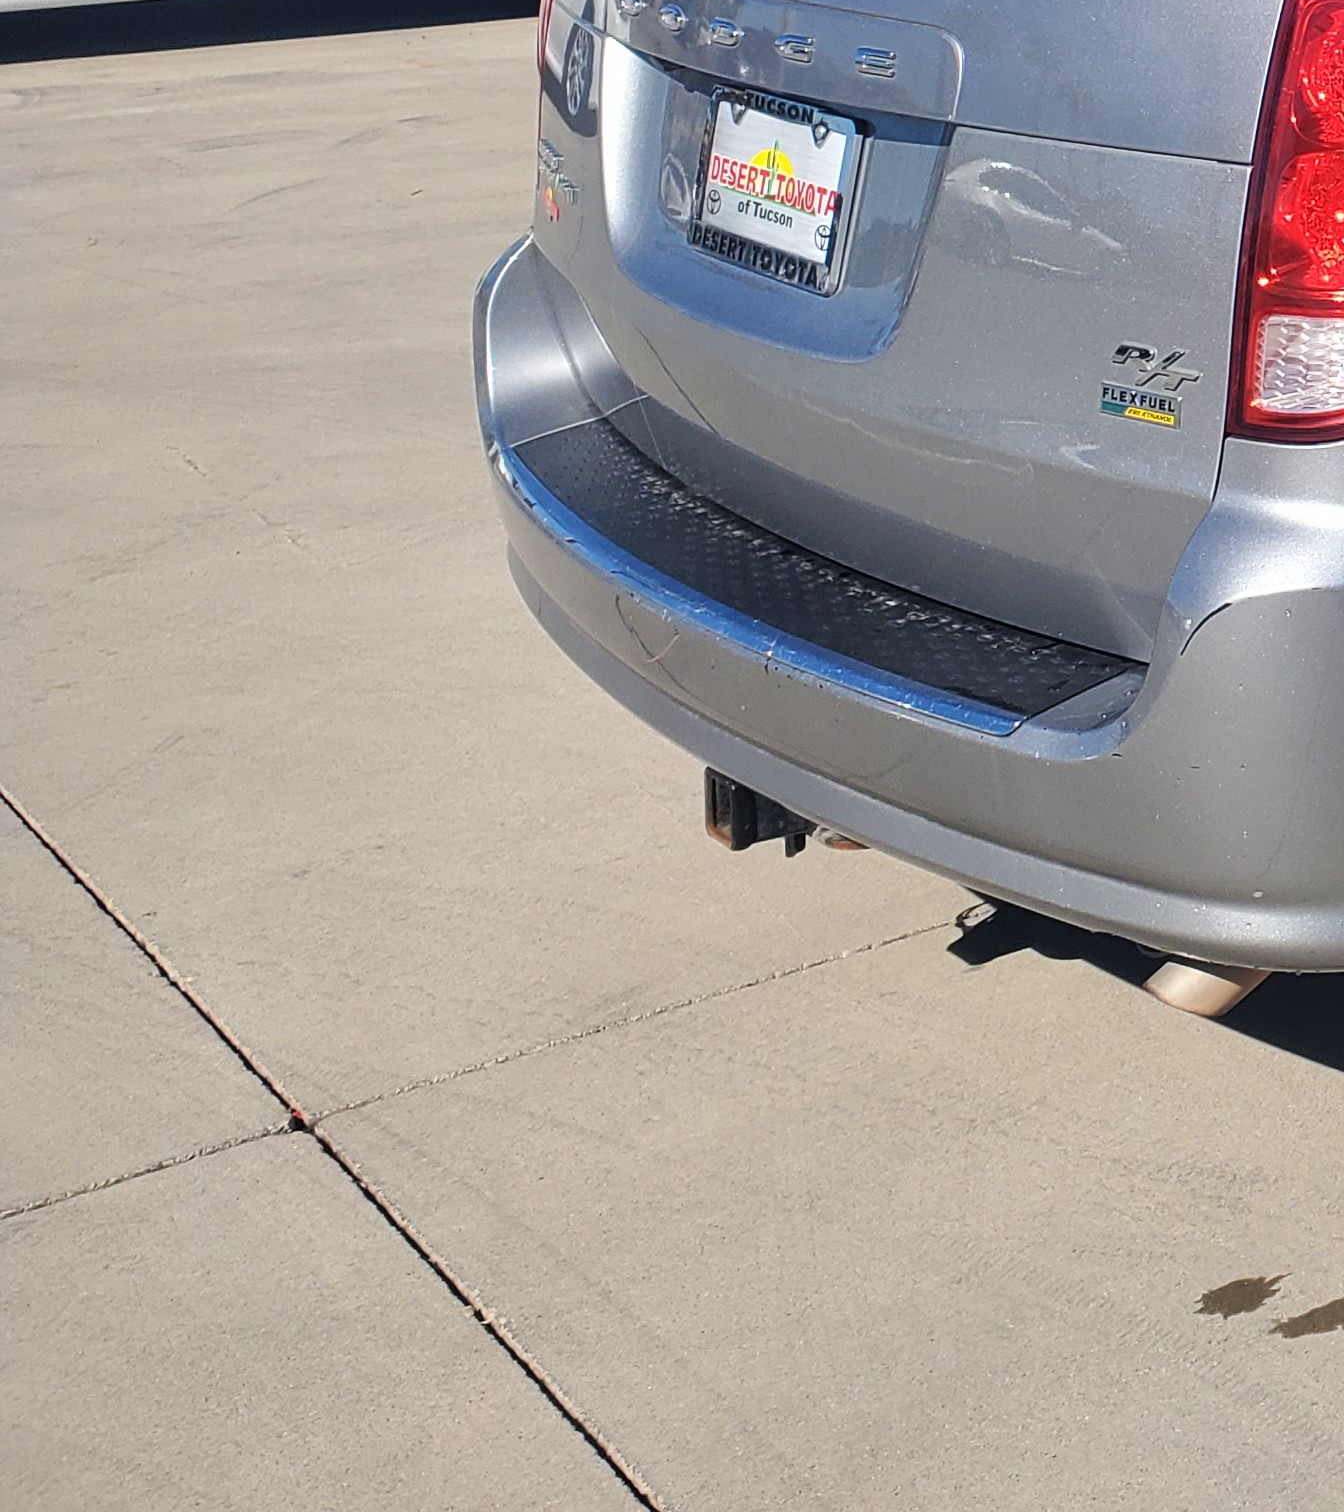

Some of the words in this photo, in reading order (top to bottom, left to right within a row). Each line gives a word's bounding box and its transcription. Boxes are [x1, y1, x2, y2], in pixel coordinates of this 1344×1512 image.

[745, 91, 815, 124] TUCSON
[711, 155, 769, 196] DESERT
[775, 173, 838, 217] TOYOTA
[737, 199, 753, 215] of
[753, 201, 793, 229] Tucson
[692, 221, 747, 262] DESERT
[751, 245, 819, 290] TOYOTA
[1111, 342, 1200, 392] R/T
